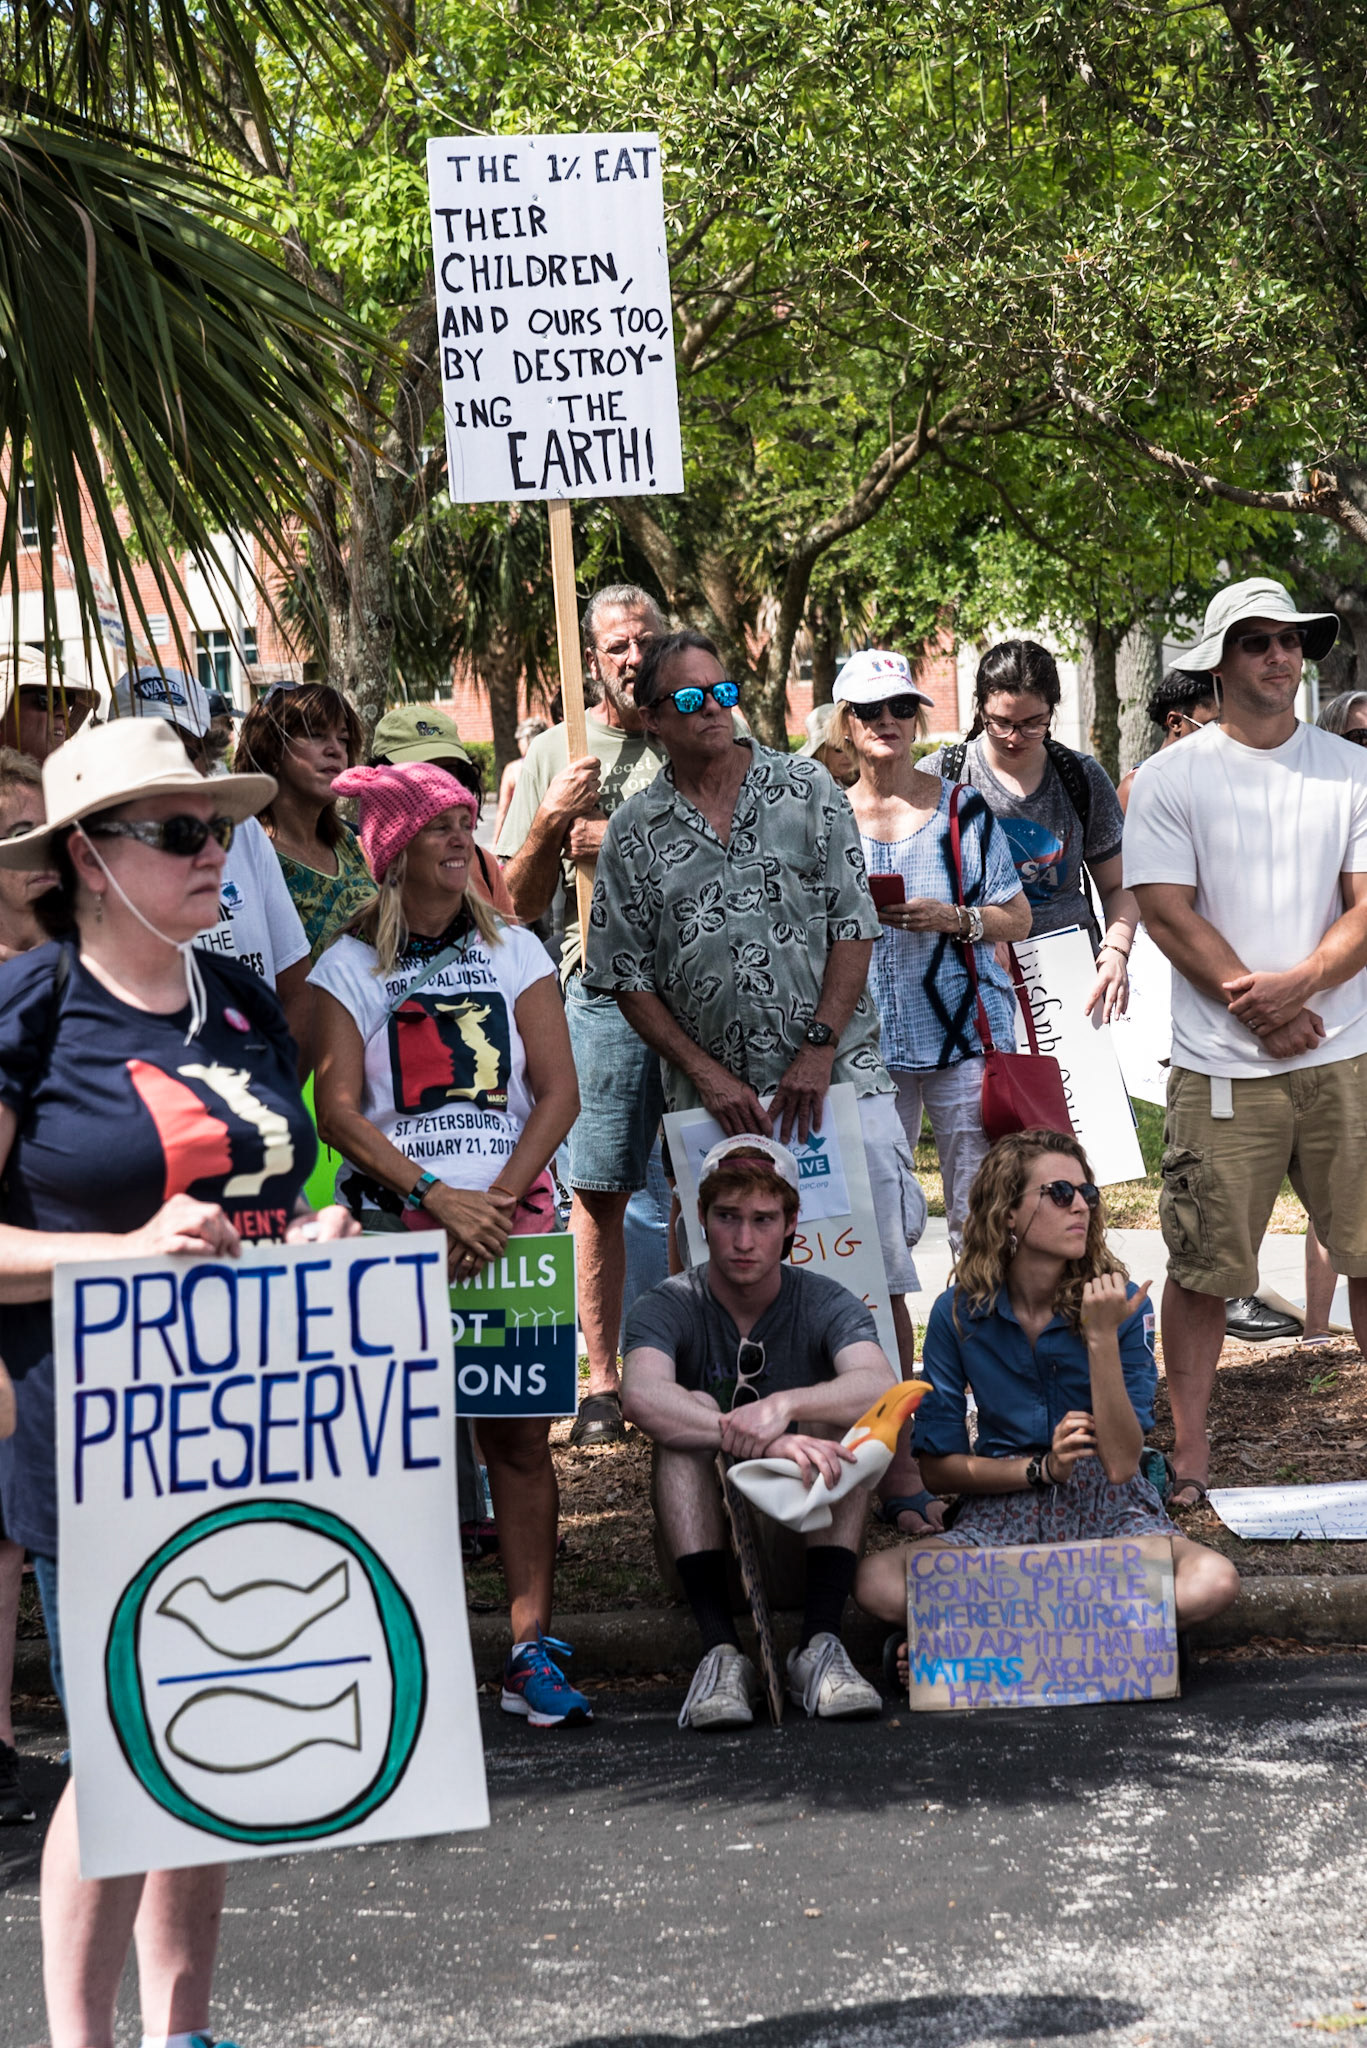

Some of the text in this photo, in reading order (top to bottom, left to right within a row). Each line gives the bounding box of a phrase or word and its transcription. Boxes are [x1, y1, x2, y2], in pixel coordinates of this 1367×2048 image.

[447, 147, 657, 183] THE 1% EAT
[435, 204, 548, 243] THEIR
[441, 251, 633, 294] CHILDREN,
[442, 306, 669, 340] AND OURS TOO,
[444, 343, 663, 384] BY DESTROY-
[455, 391, 628, 428] ING THE
[507, 426, 656, 490] EARTH!
[197, 930, 235, 953] THE
[385, 978, 408, 997] FOR
[395, 1121, 411, 1137] ST.
[415, 1113, 505, 1134] PETERSBURG,
[466, 1137, 486, 1156] 21,
[74, 1252, 439, 1385] PROTECT
[74, 1358, 440, 1505] PRESERVE
[910, 1543, 1145, 1580] COME GATHER
[1032, 1573, 1151, 1603] PEOPLE
[912, 1598, 1168, 1631] WHEREVER YOU ROAM
[915, 1630, 971, 1658] AND
[975, 1629, 1072, 1658] ADMIT
[1074, 1629, 1139, 1657] THAT
[909, 1649, 1175, 1688] WATERS AROUND YOU
[947, 1678, 1153, 1708] HAVE GROWN
